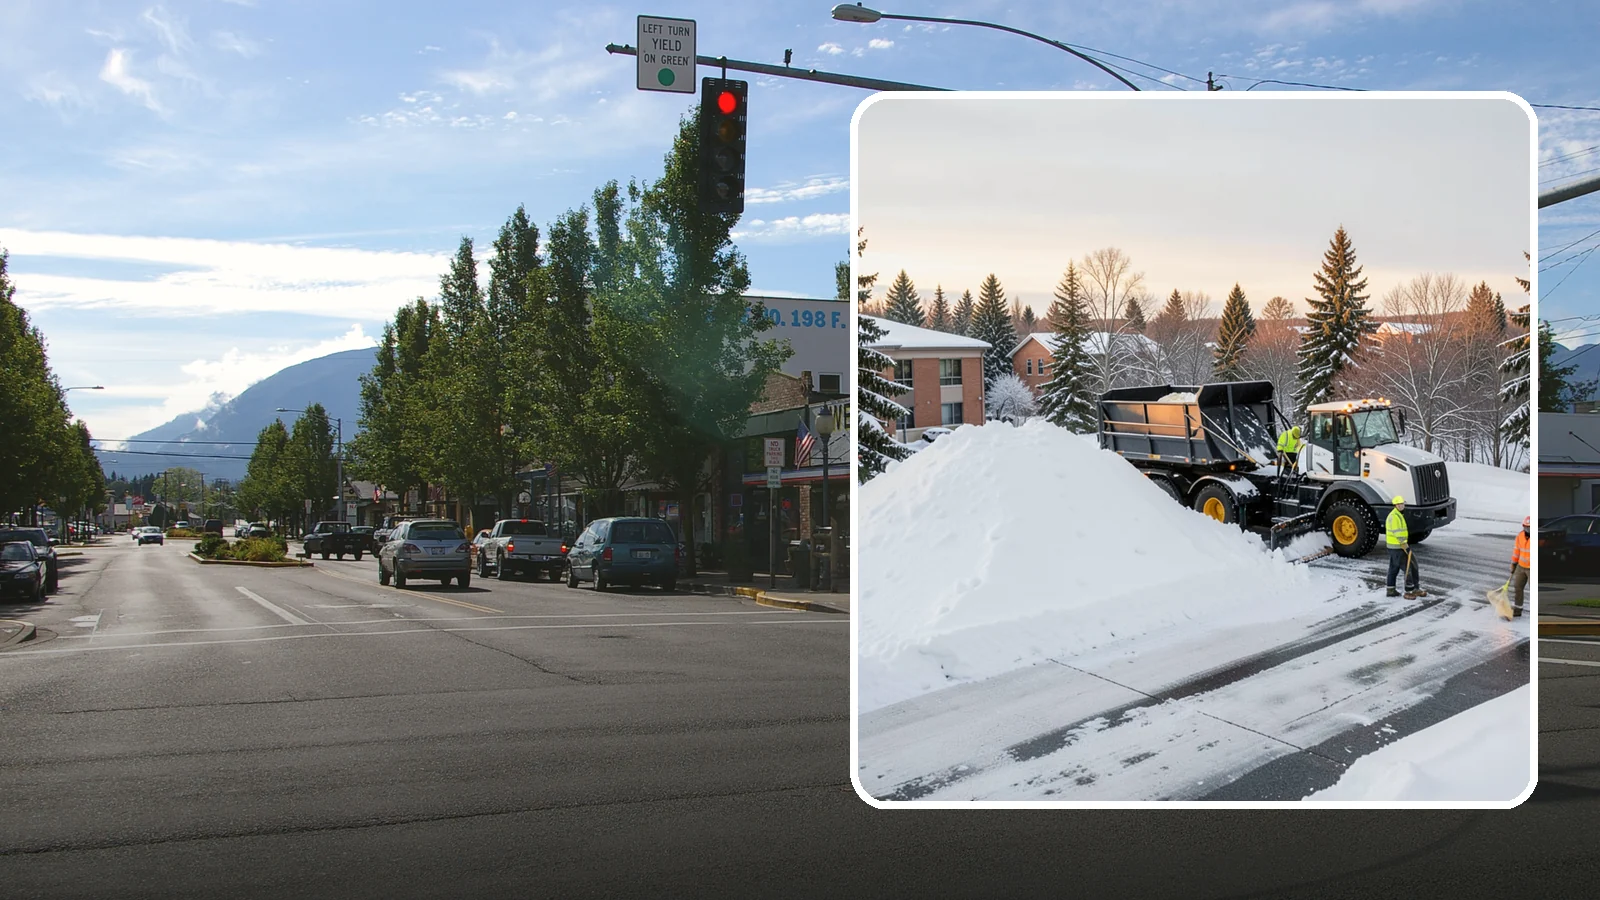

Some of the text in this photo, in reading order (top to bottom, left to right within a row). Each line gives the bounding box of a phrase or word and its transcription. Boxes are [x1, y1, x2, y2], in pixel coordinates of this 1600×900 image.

[643, 23, 690, 36] LEFT TURN
[652, 38, 682, 51] YIELD
[791, 309, 826, 328] 198
[831, 311, 847, 329] F.
